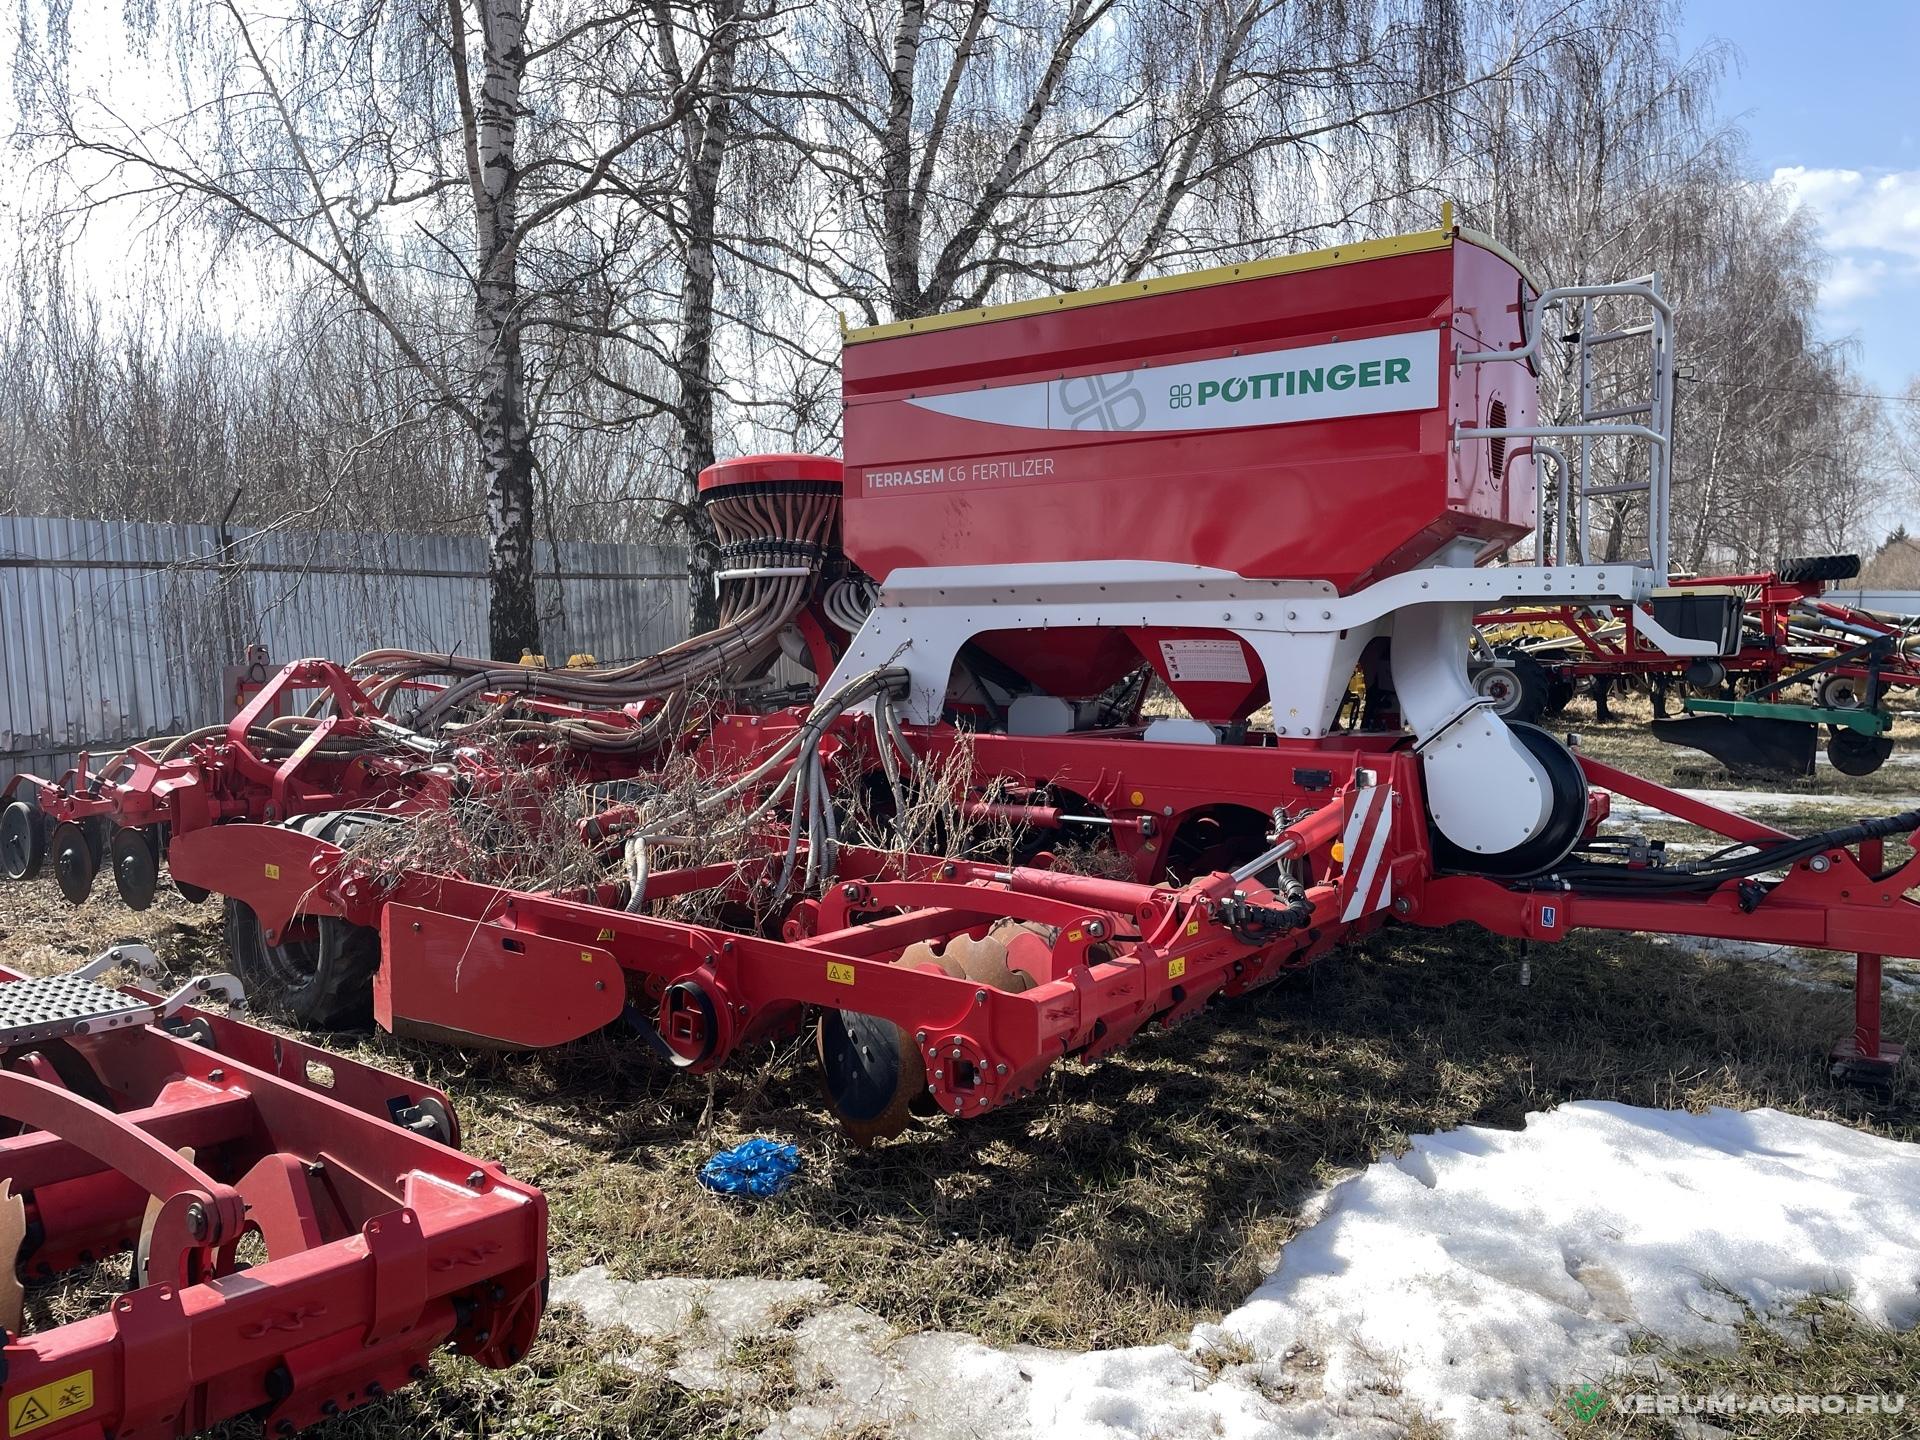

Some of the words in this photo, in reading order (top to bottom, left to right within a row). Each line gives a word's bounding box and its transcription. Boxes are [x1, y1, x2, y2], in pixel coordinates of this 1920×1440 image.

[1198, 357, 1411, 406] PÖTTINGER
[866, 468, 944, 488] TERRASEM
[948, 466, 966, 482] C6
[972, 458, 1054, 480] FERTILIZER
